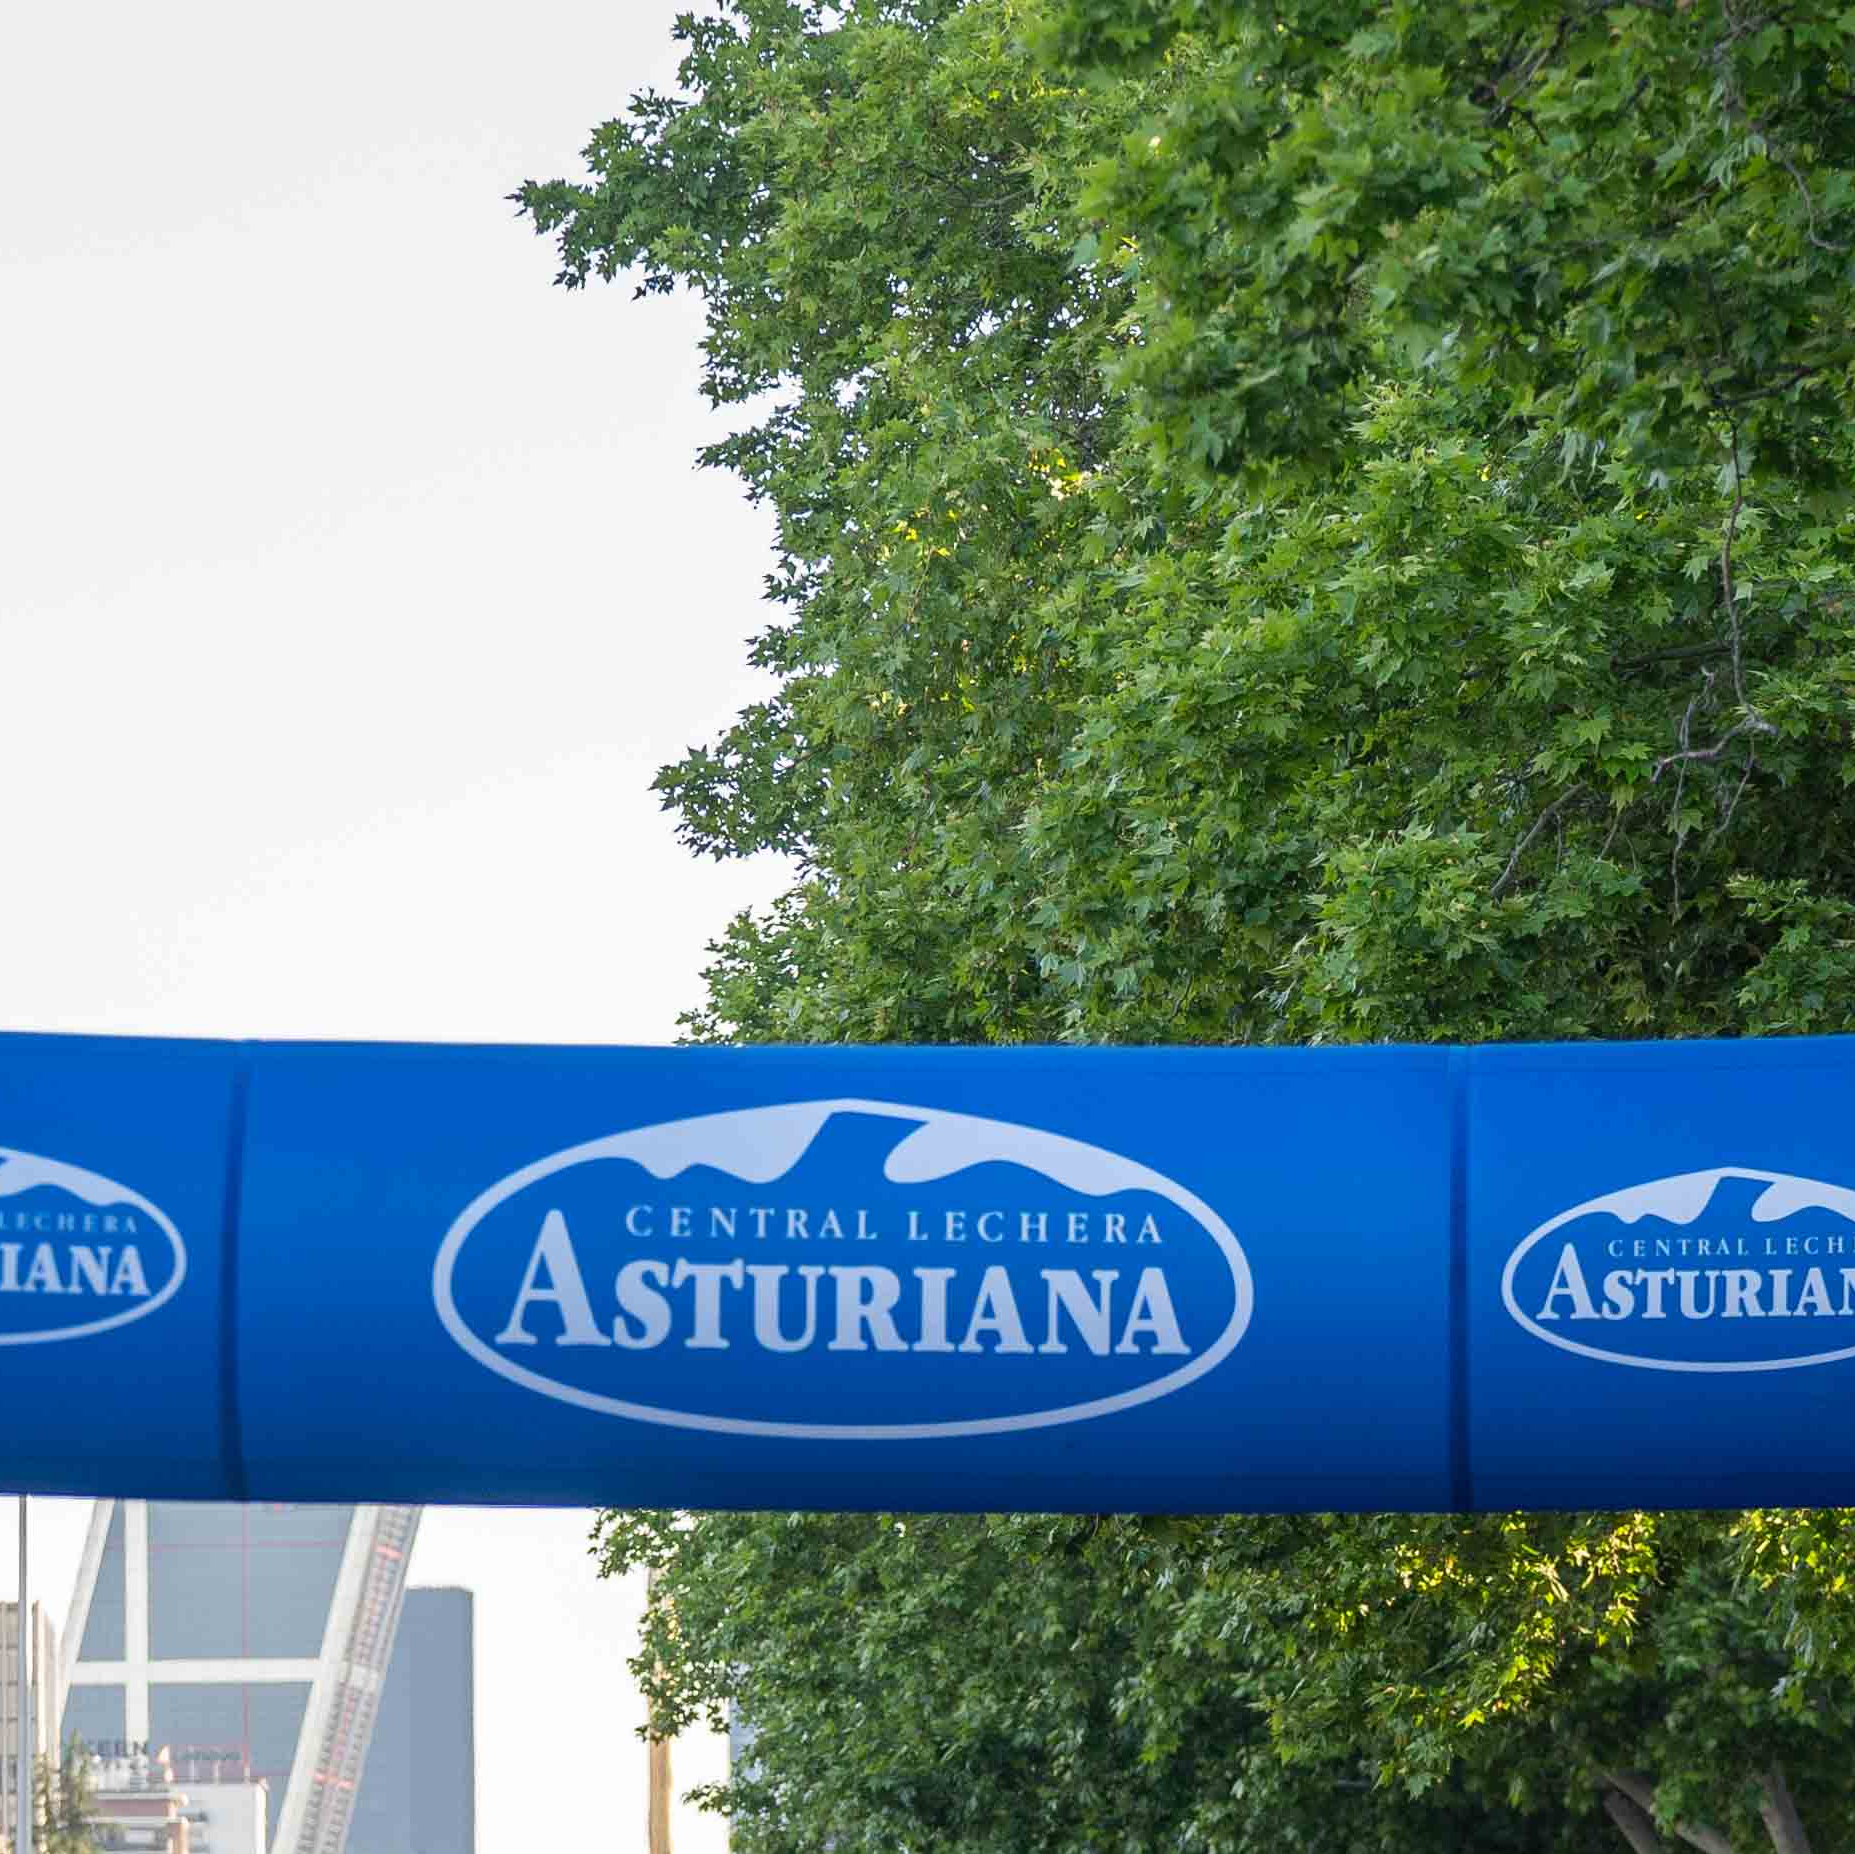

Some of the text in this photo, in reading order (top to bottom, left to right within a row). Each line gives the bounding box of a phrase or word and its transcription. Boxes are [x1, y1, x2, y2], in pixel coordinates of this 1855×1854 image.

[625, 1205, 1164, 1245] CENTRAL LECHERA
[1607, 1237, 1750, 1258] CENTRAL
[494, 1209, 1192, 1356] ASTURIANA
